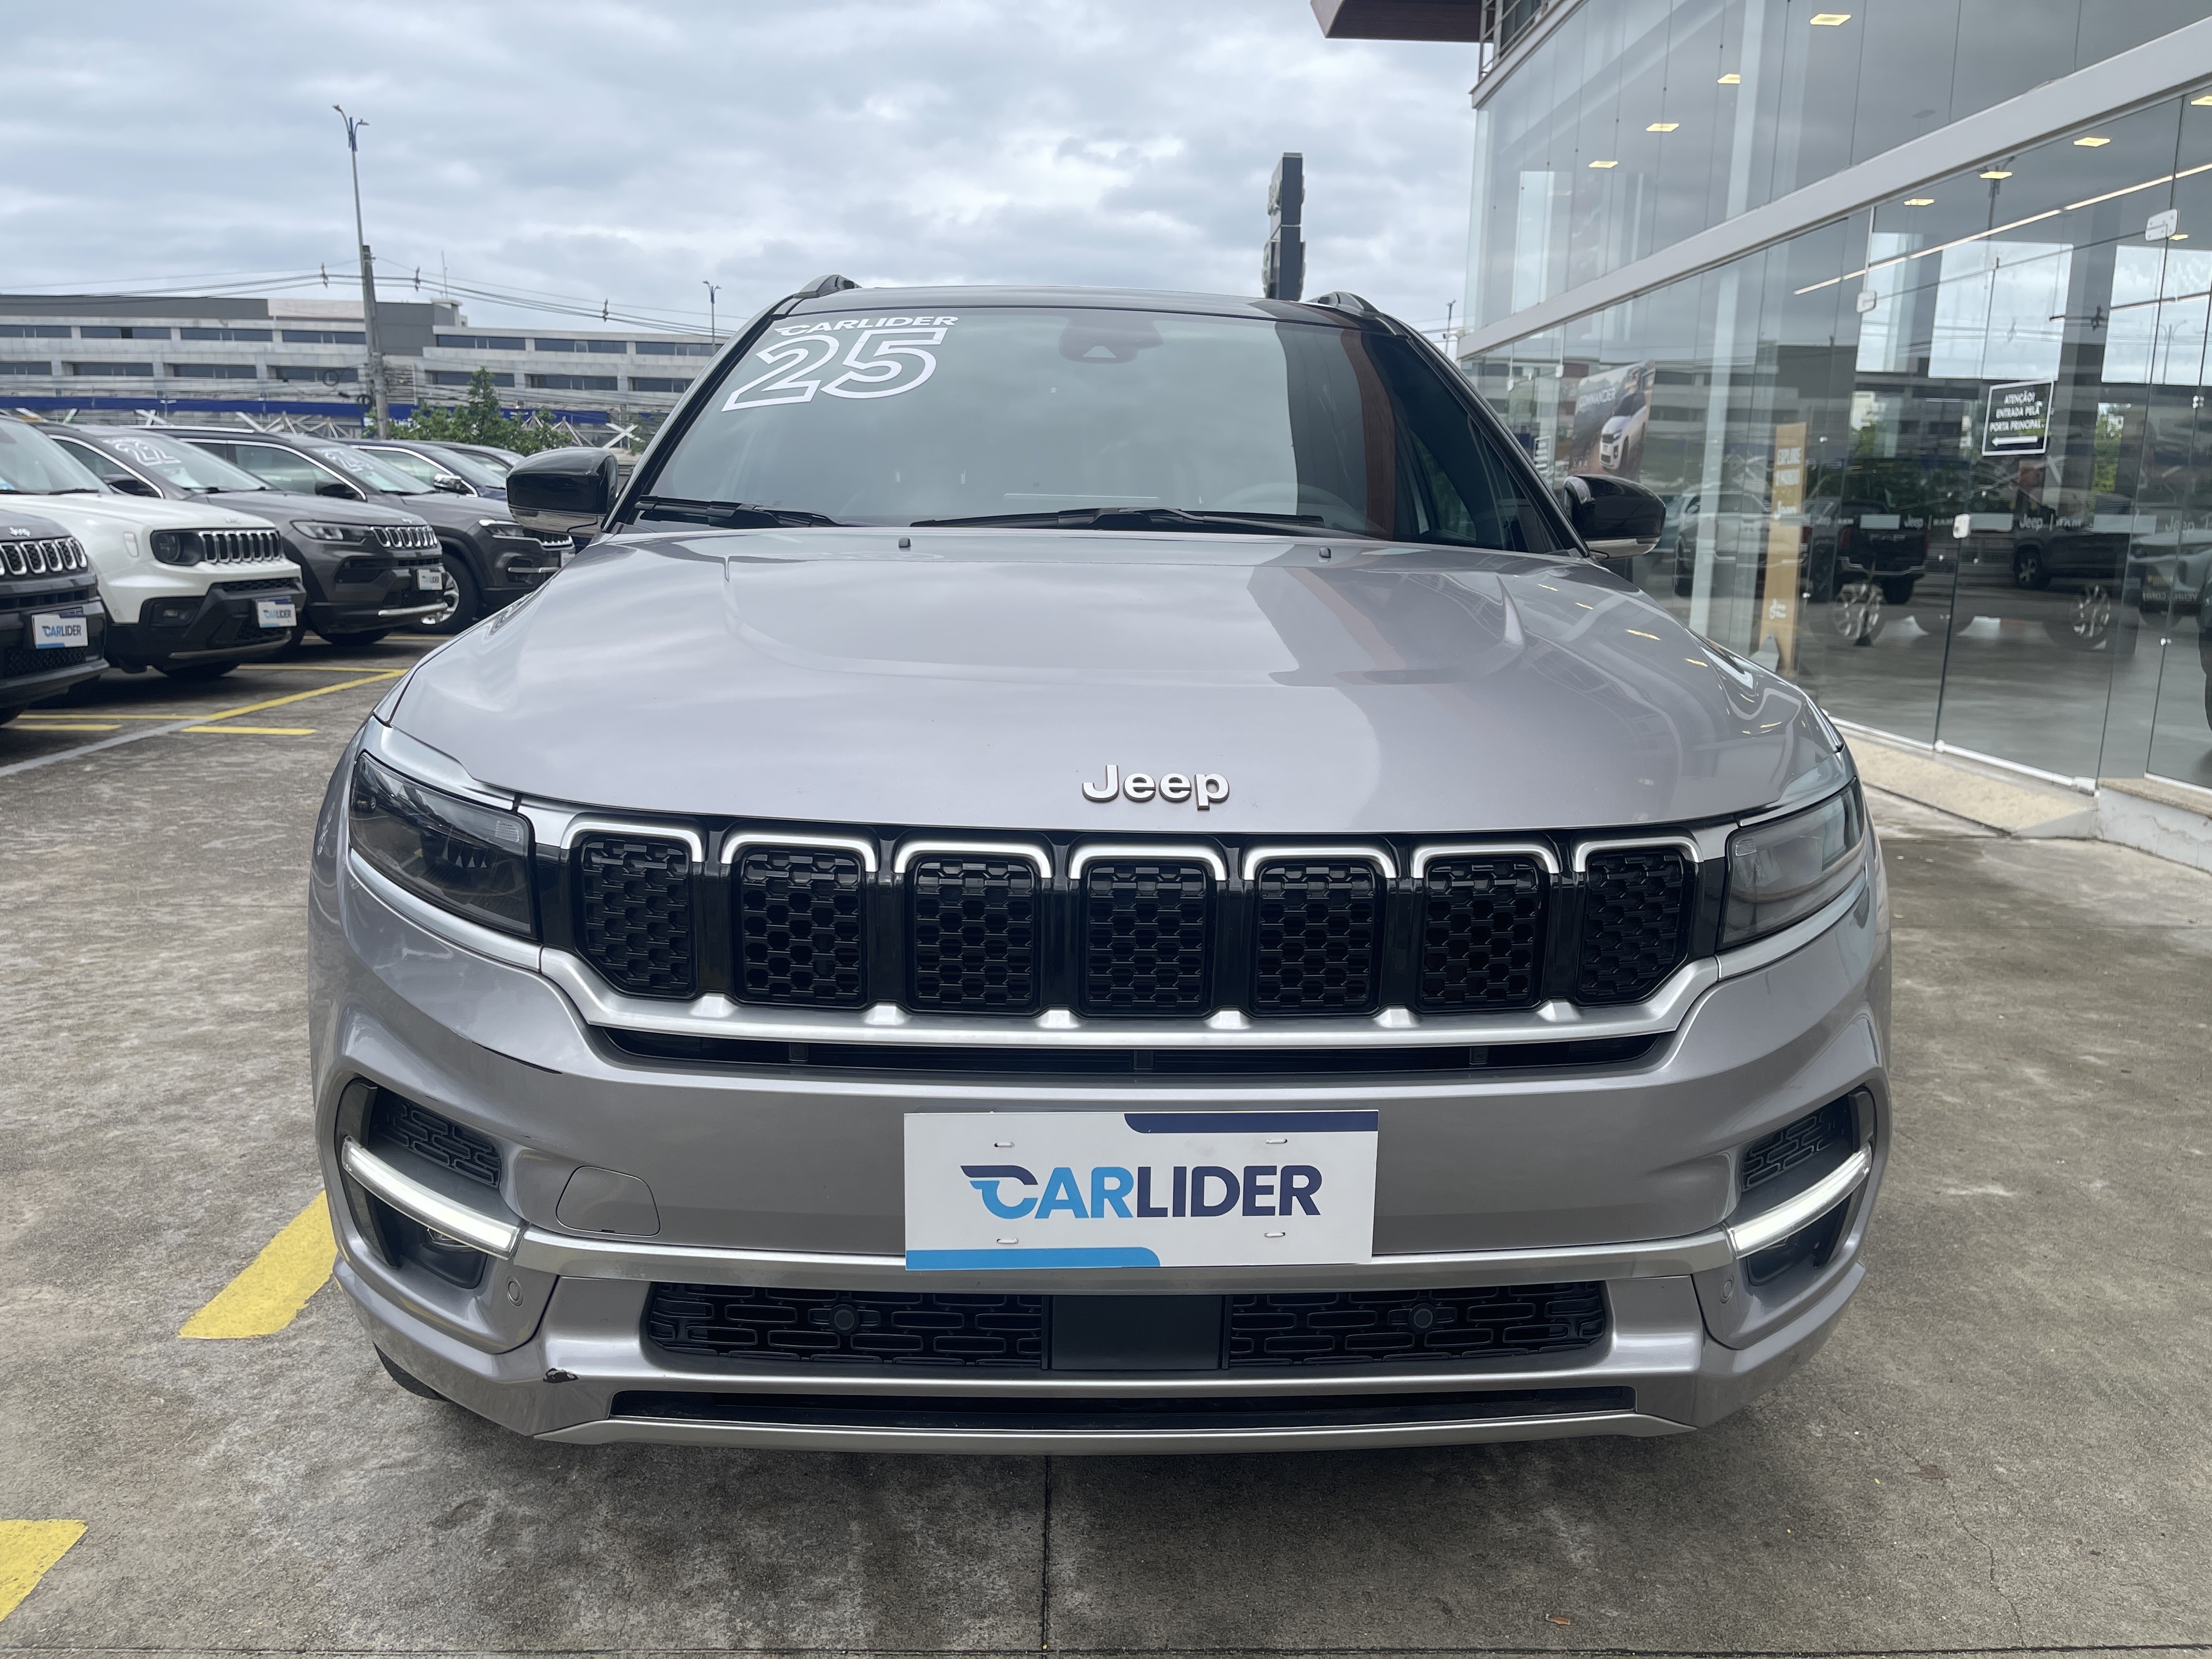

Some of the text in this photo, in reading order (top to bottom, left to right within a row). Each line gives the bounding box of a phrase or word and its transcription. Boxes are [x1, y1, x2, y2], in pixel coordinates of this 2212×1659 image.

[774, 316, 959, 336] CARLIDER
[721, 328, 948, 412] 25
[1579, 388, 1616, 408] COMMANDER
[42, 624, 81, 637] CARLIDER
[1082, 764, 1230, 811] Jeep
[960, 1165, 1322, 1219] CARLIDER
